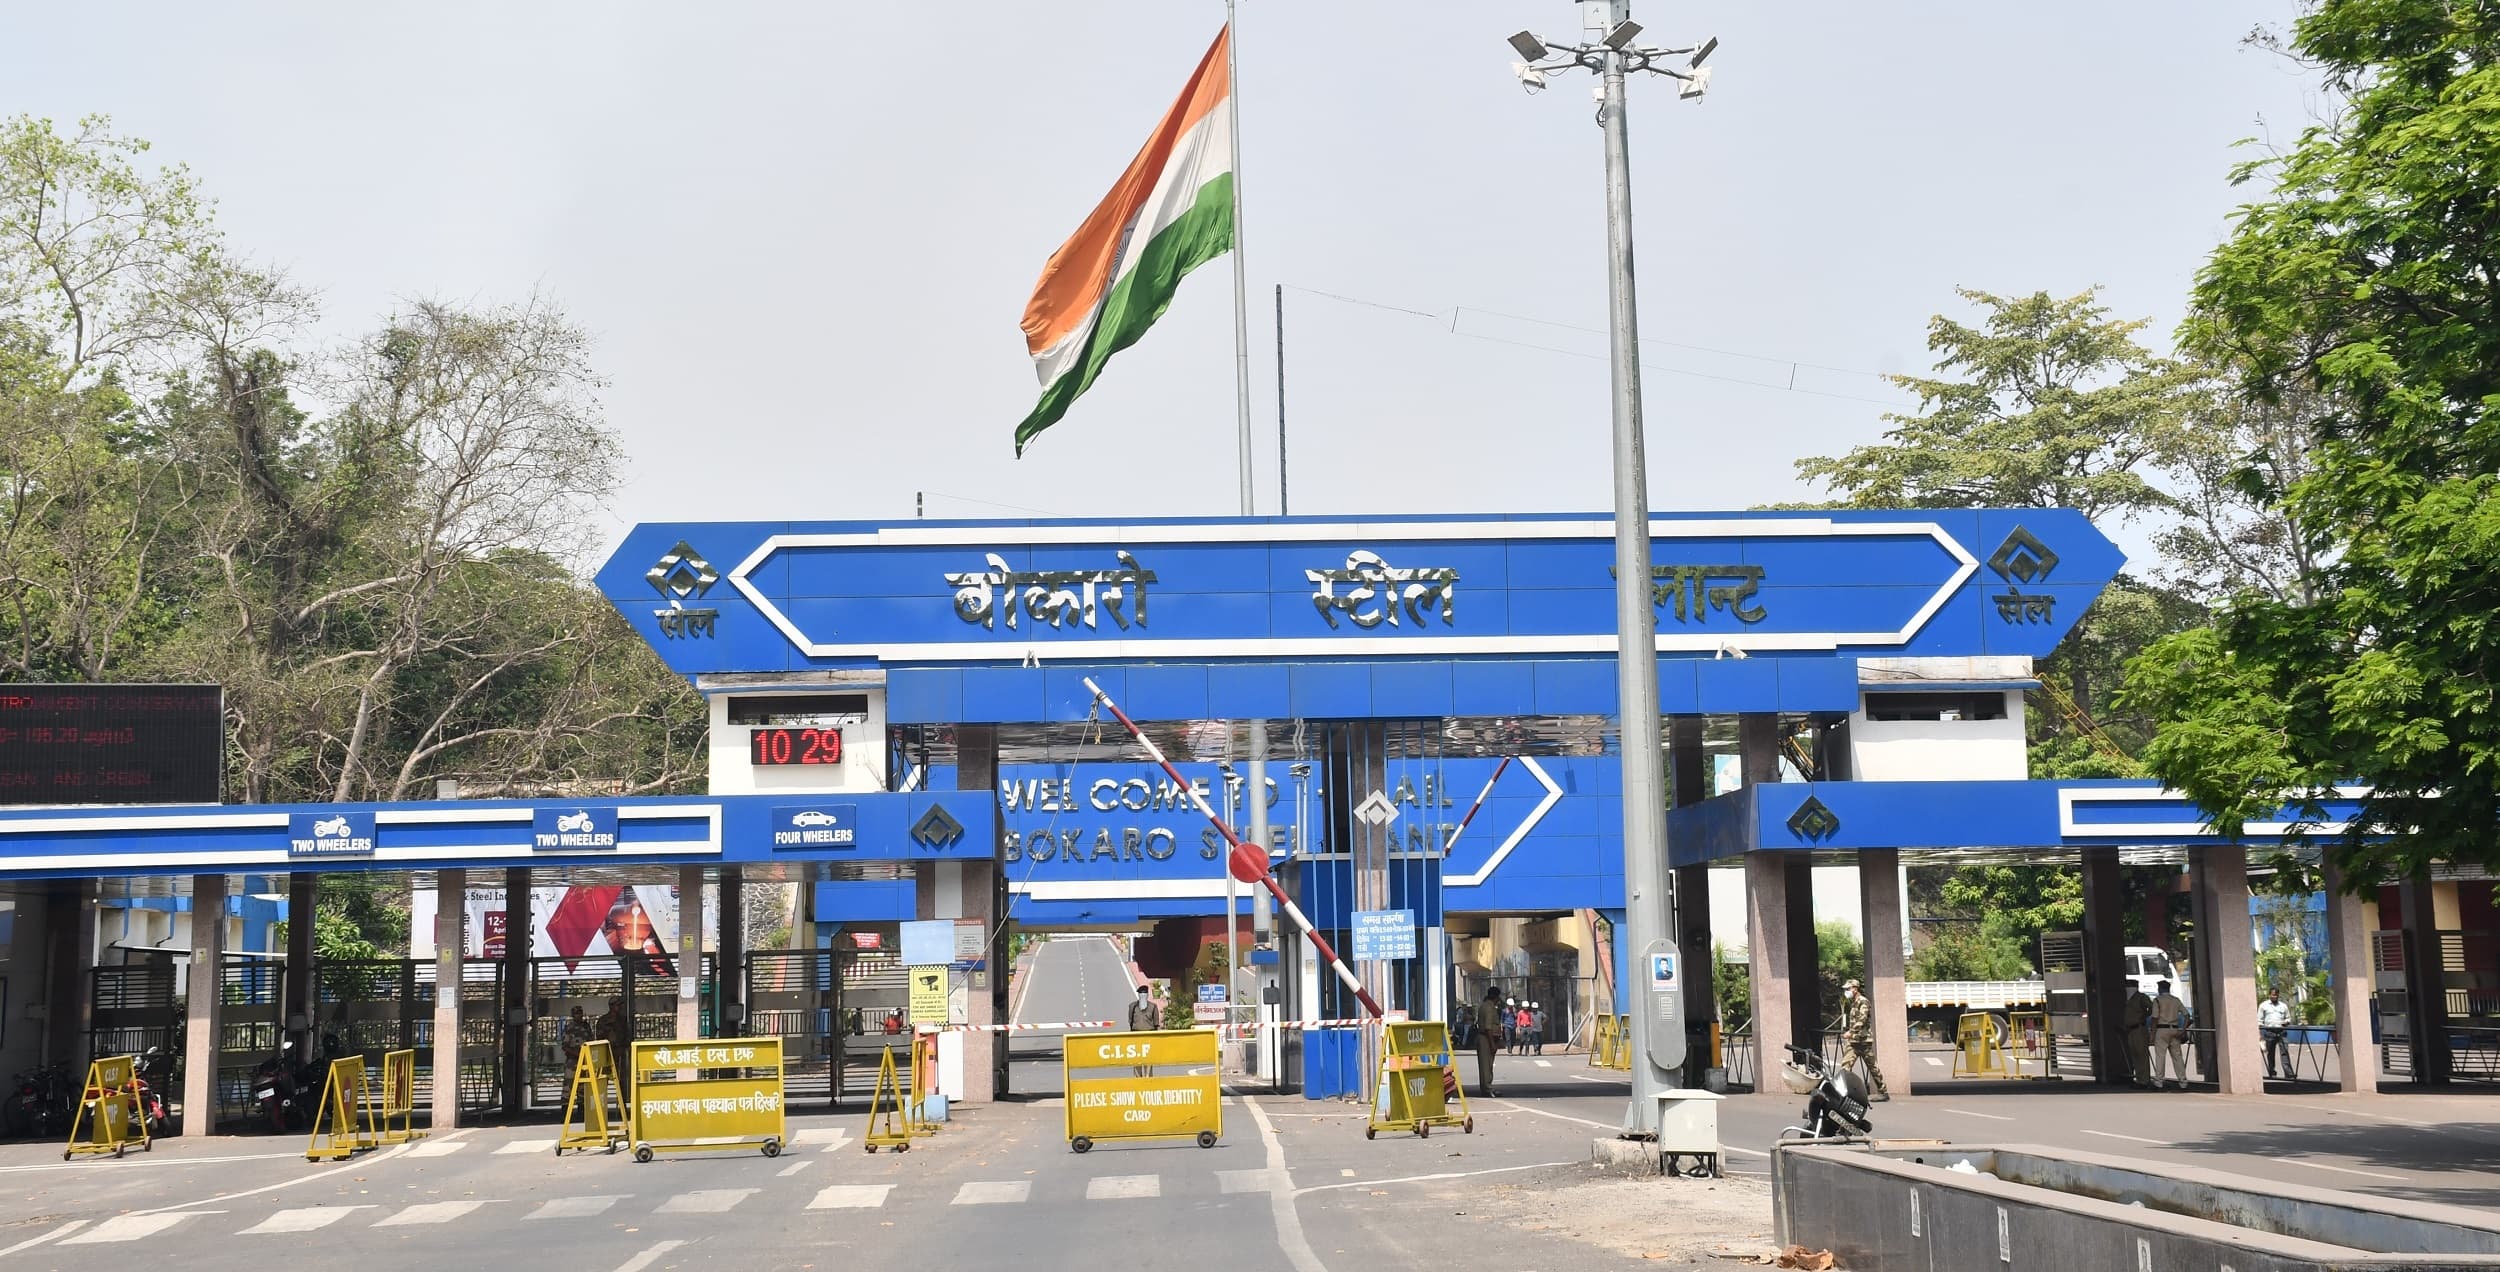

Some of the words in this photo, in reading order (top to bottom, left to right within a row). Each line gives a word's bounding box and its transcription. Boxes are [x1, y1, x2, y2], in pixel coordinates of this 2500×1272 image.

[944, 550, 1158, 631] बोकारो
[1305, 550, 1460, 630] स्टील
[1992, 586, 2056, 625] सेल
[653, 600, 719, 640] सेल
[755, 729, 791, 765] 10
[801, 728, 840, 764] 29
[292, 839, 314, 852] TWO
[317, 838, 371, 852] WHEELERS
[536, 834, 557, 847] TWO
[558, 833, 614, 847] WHEELERS
[775, 831, 801, 844] FOUR
[802, 829, 853, 843] WHEELERS
[1004, 827, 1176, 861] BOKARO
[471, 891, 492, 901] Steel
[641, 1100, 671, 1119] कृपया
[672, 1098, 700, 1115] अपना
[702, 1097, 737, 1113] पहचान
[738, 1095, 754, 1112] पत्र
[1074, 1091, 1107, 1108] PLEASE
[1110, 1090, 1136, 1106] SHOW
[1138, 1090, 1163, 1106] YOUR
[1164, 1089, 1203, 1105] IDENTITY
[1124, 1110, 1151, 1122] CARD
